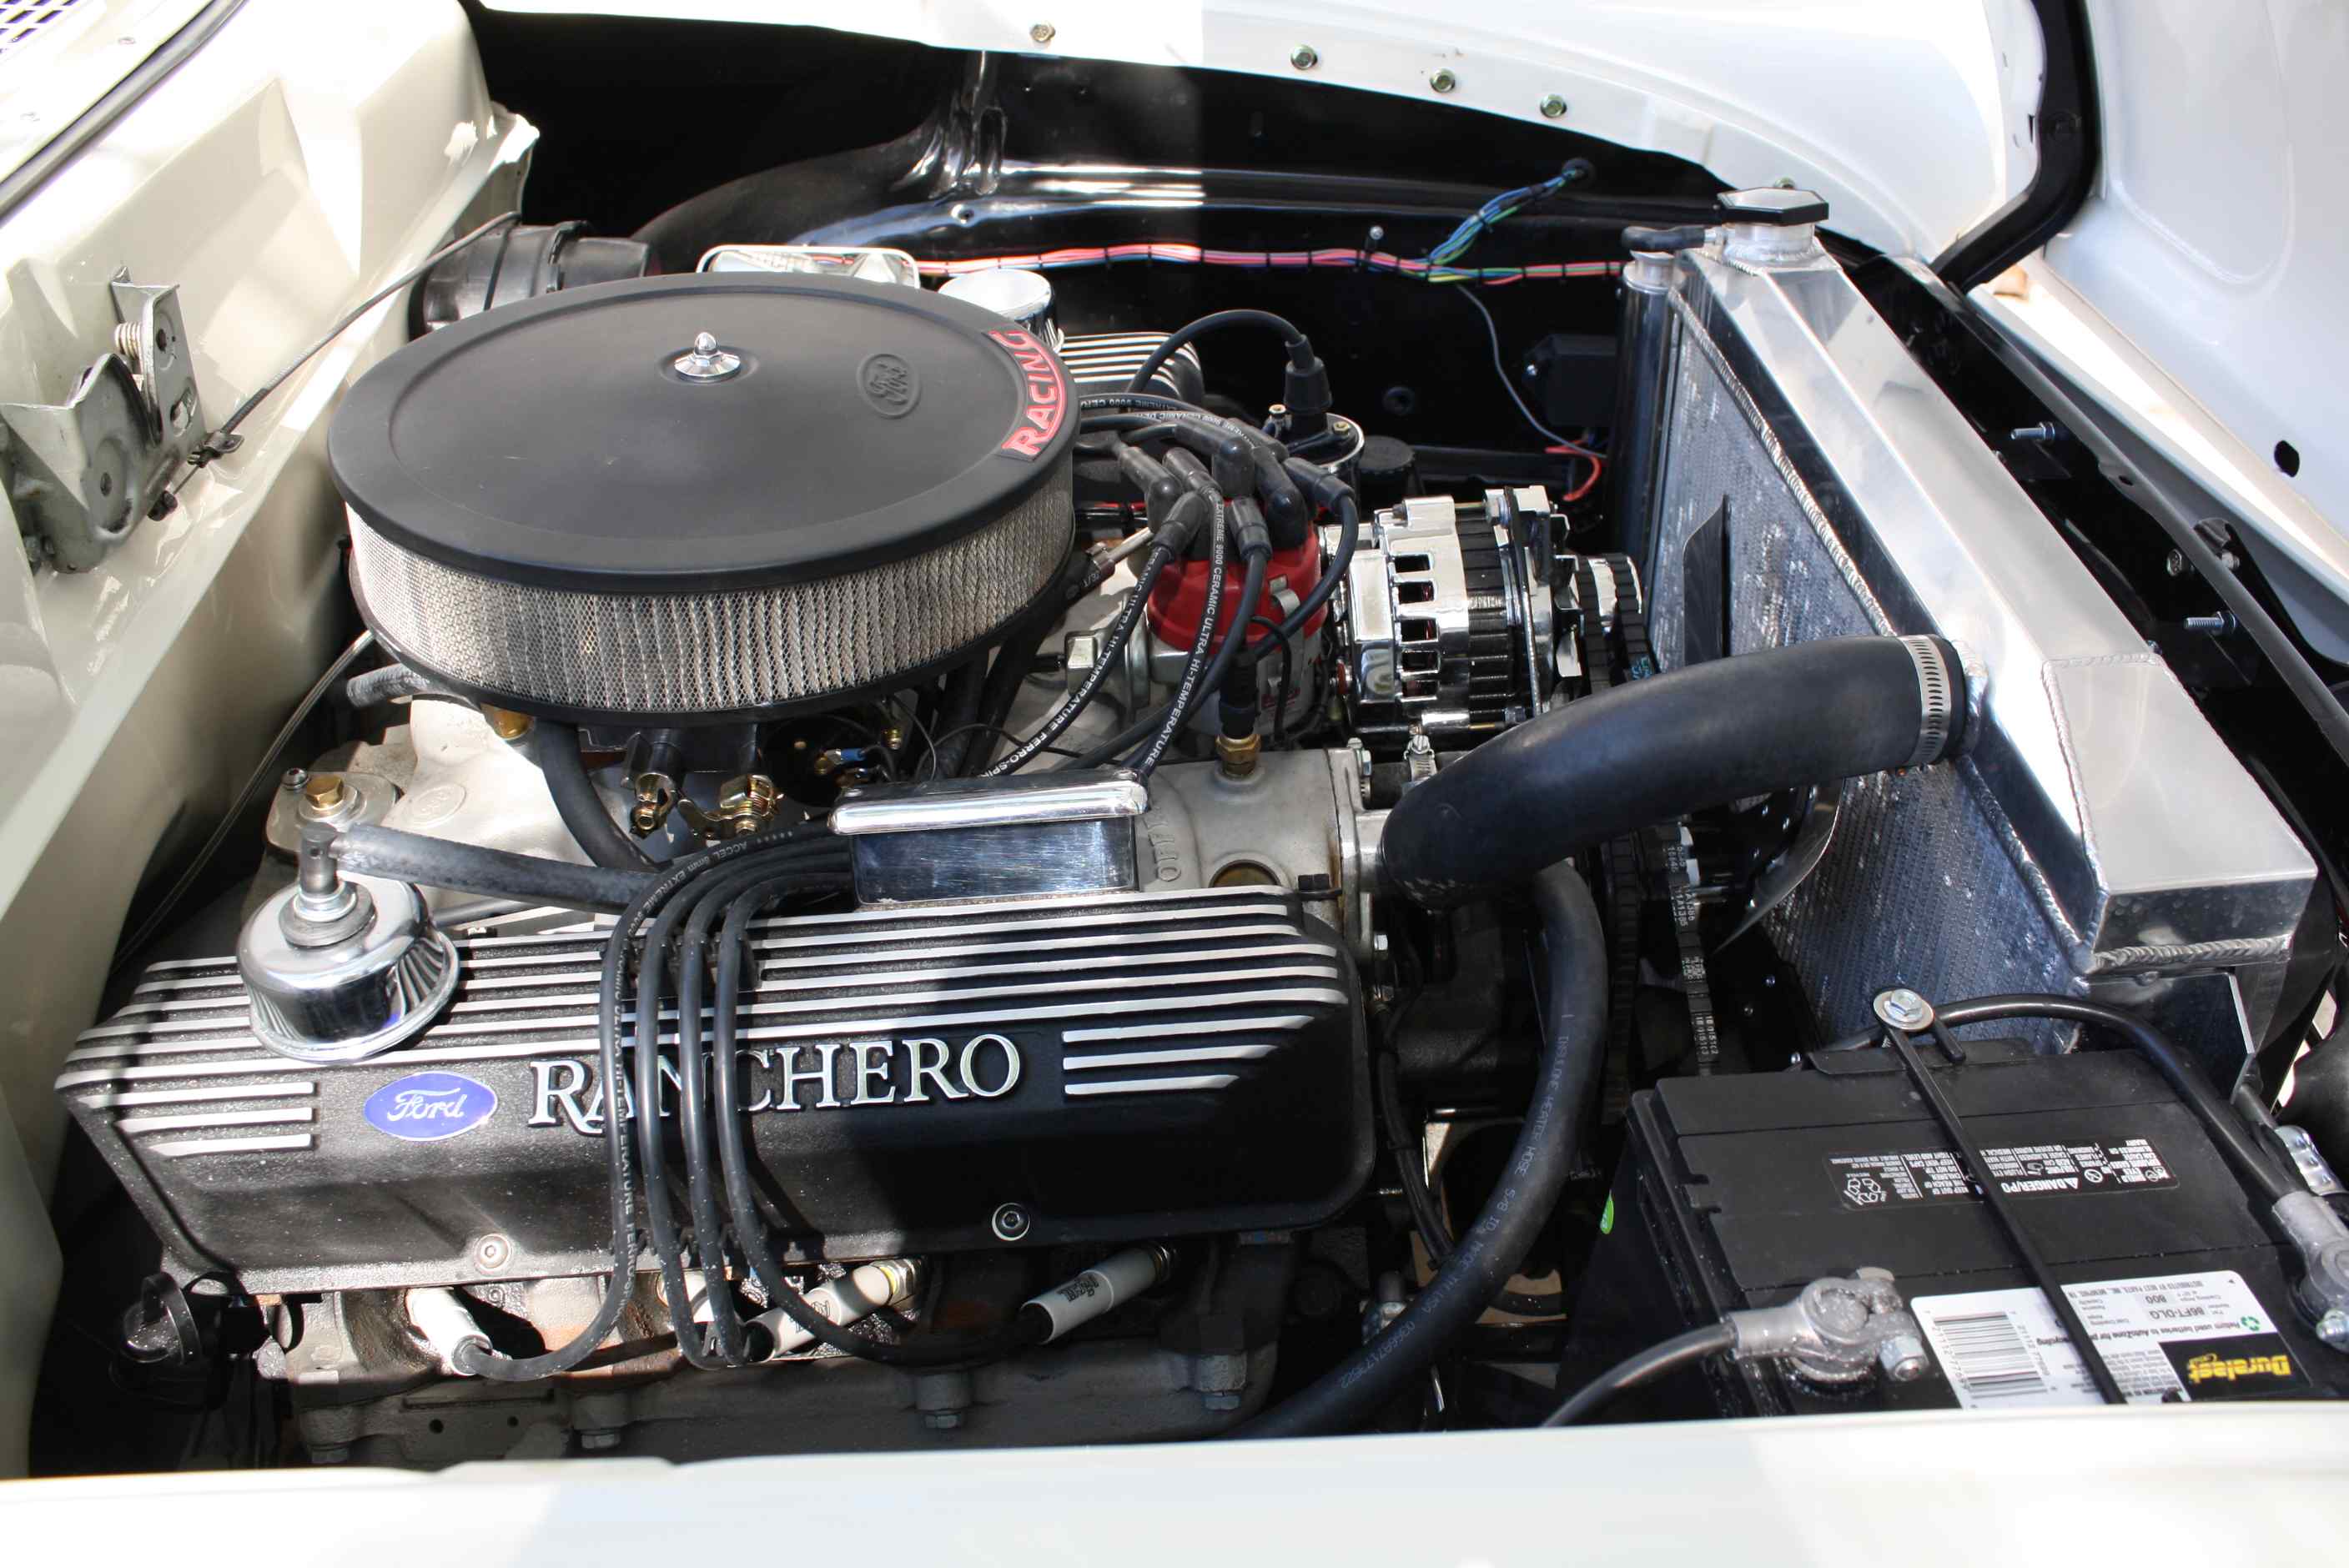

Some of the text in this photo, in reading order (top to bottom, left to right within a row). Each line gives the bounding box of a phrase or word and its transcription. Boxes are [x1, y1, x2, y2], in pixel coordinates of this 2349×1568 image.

[988, 330, 1066, 455] RACING
[1215, 544, 1224, 565] 9000
[1207, 567, 1222, 615] CERAMIC
[1119, 593, 1139, 631] ULTRA
[1195, 617, 1215, 655] ULTRA
[1049, 634, 1119, 731] HI-TEMPERATURE
[1144, 657, 1201, 766] HI-TEMPERATURE
[712, 840, 748, 862] ACCEL
[642, 869, 687, 914] EXTREME
[386, 1085, 467, 1123] Ford
[1531, 1095, 1554, 1142] HEATER
[1515, 1146, 1536, 1176] HOSE
[2000, 1179, 2068, 1194] DANGER/PO
[2145, 1294, 2167, 1304] 800
[2149, 1307, 2205, 1319] 86FT-DLG
[2113, 1329, 2150, 1339] AutoZone
[2161, 1324, 2194, 1334] batteries
[2187, 1354, 2291, 1385] Duralast
